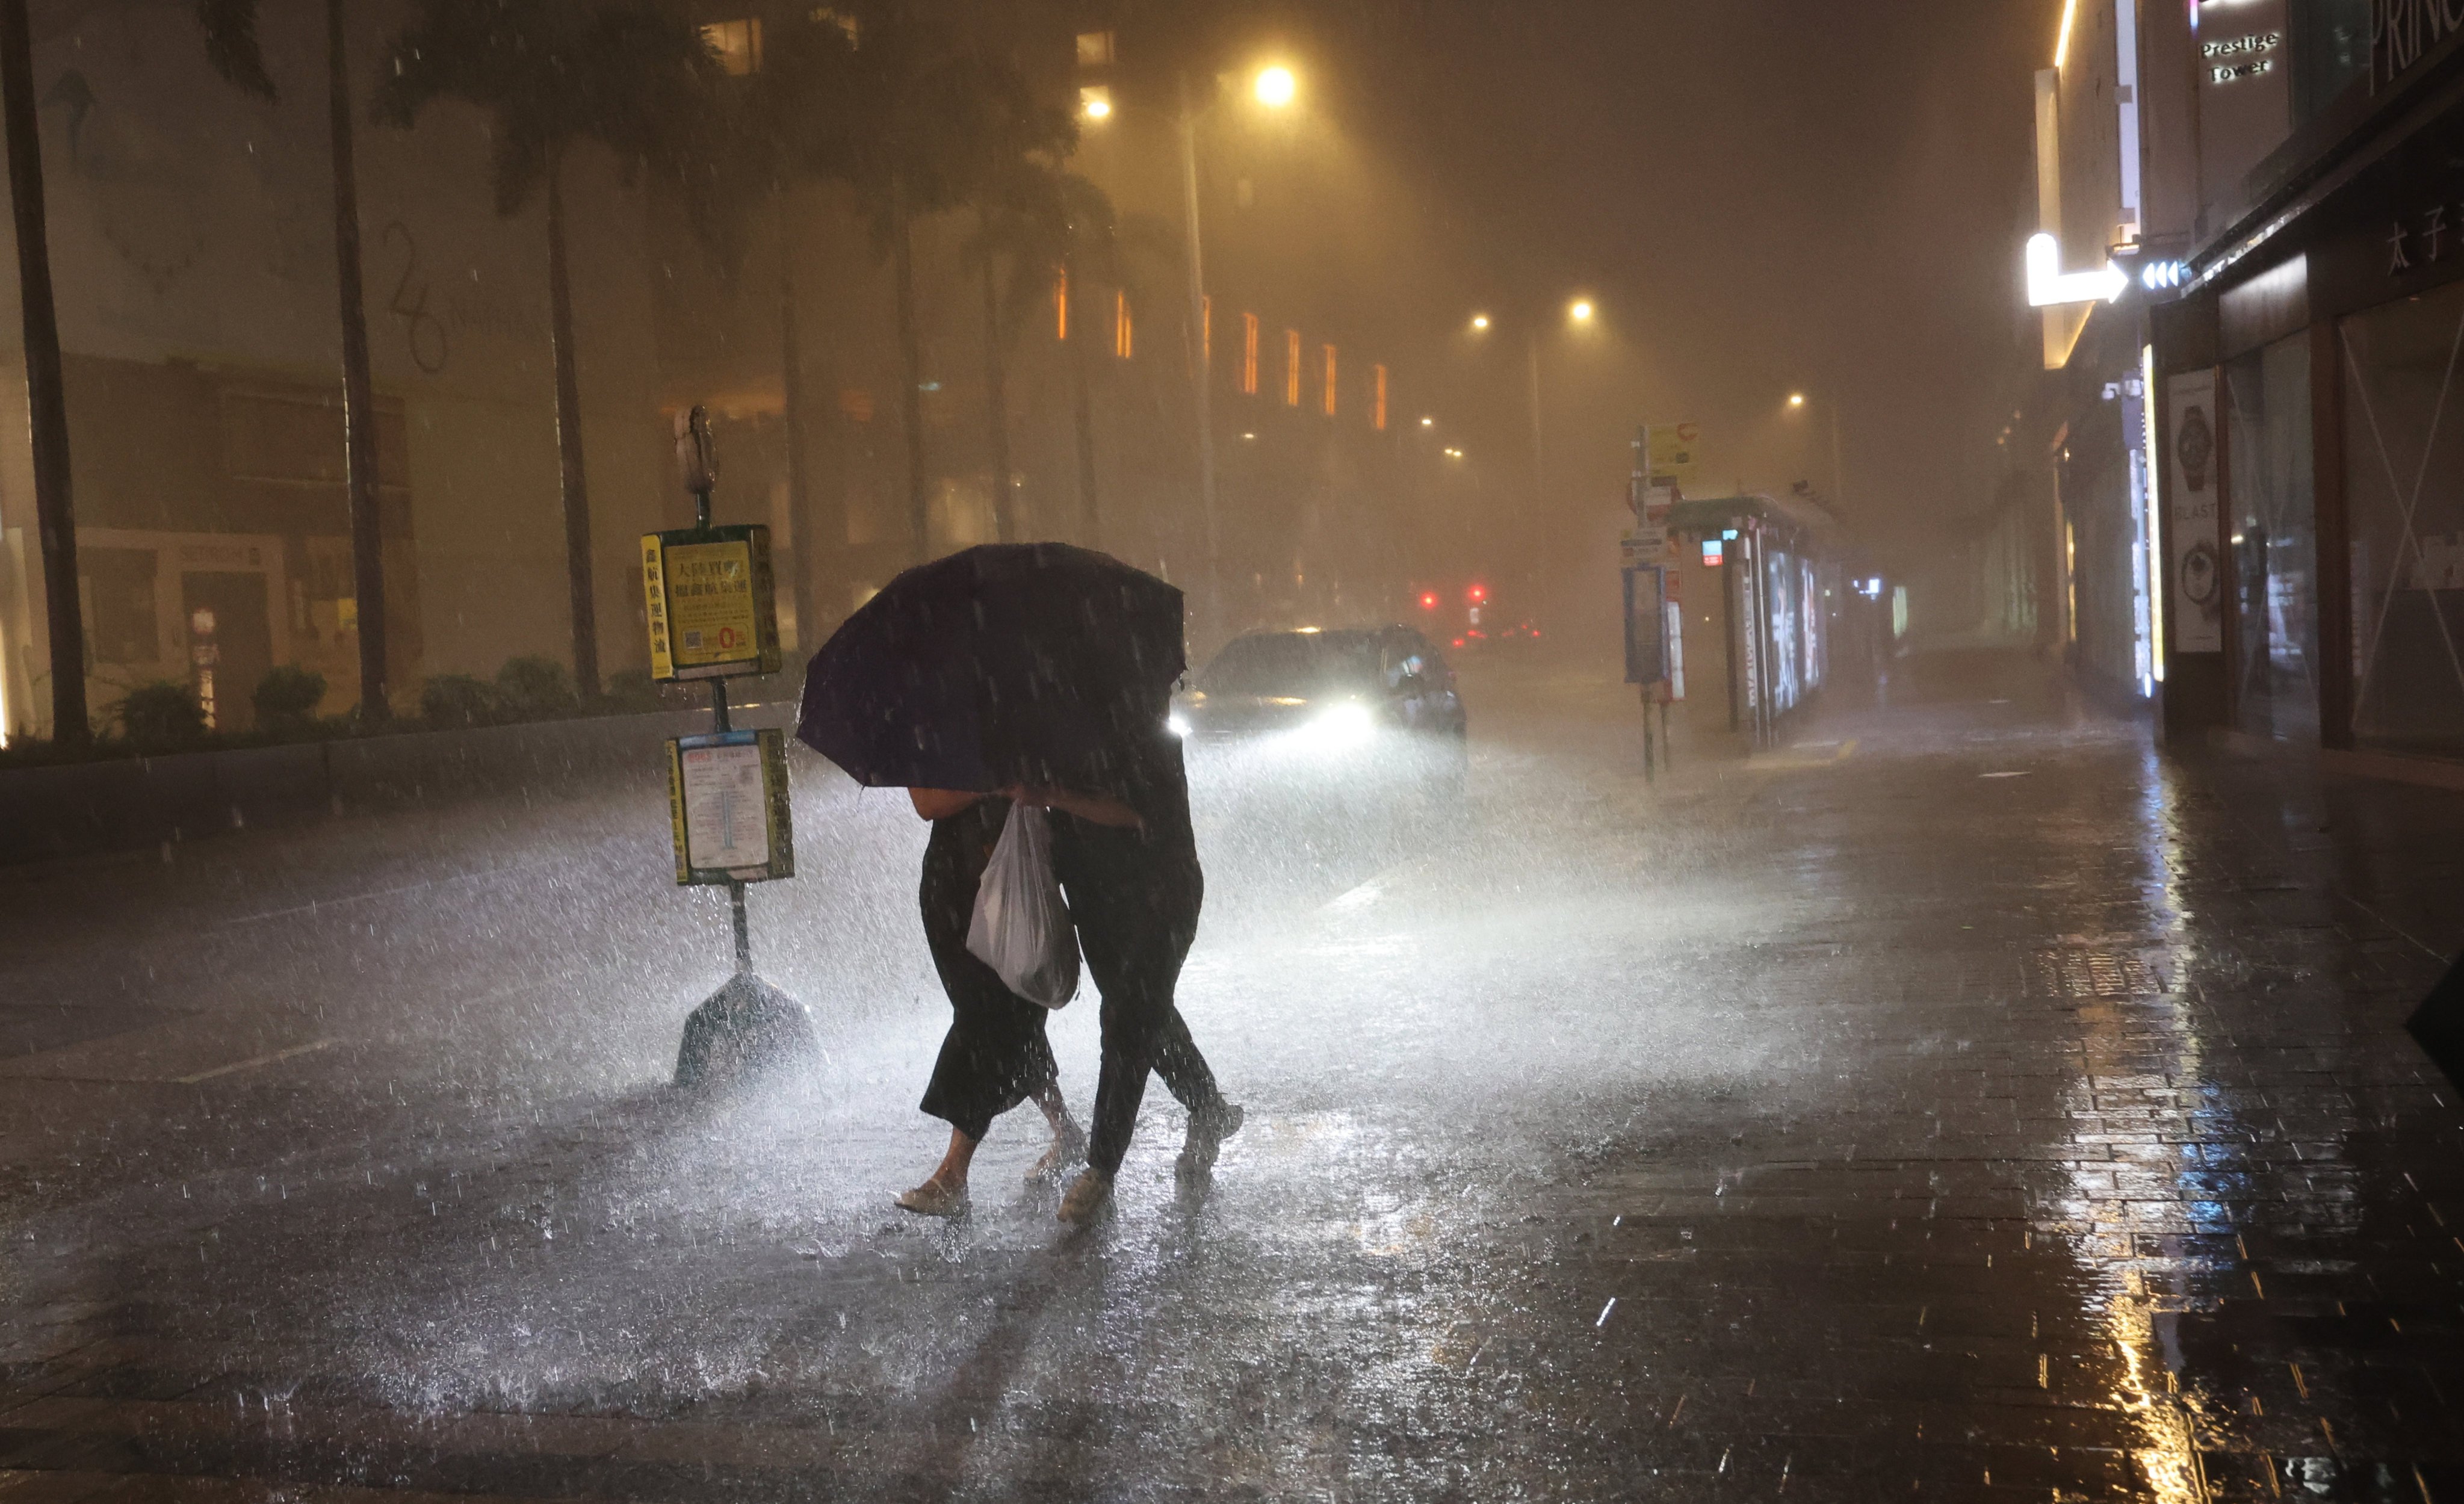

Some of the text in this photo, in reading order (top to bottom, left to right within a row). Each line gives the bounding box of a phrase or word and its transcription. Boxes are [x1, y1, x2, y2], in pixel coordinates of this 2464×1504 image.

[2200, 32, 2280, 59] Prestige
[2210, 60, 2269, 82] Tower
[2368, 0, 2464, 97] PRI
[2386, 202, 2464, 279] 太子
